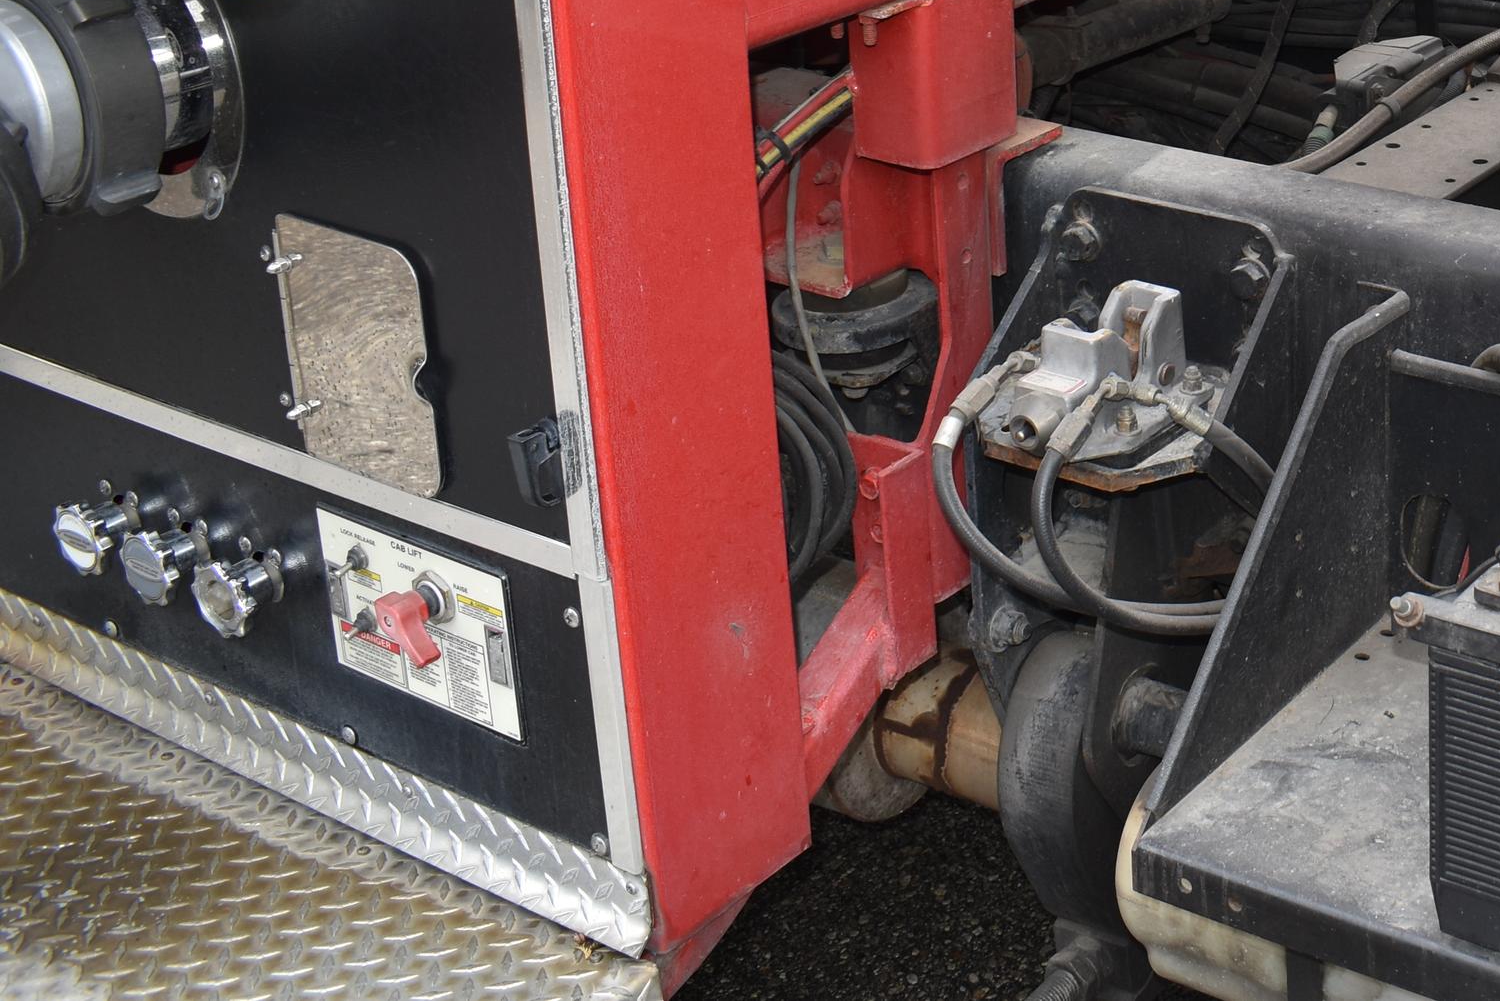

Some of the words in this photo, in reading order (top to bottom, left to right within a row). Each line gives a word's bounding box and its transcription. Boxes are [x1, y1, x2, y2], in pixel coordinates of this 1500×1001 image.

[340, 527, 353, 538] LOCK
[354, 533, 376, 547] RELEASE
[390, 541, 406, 553] CAB
[407, 547, 422, 559] LIFT
[397, 561, 415, 573] LOWER
[453, 583, 468, 594] RAISE
[360, 632, 392, 650] DANGER
